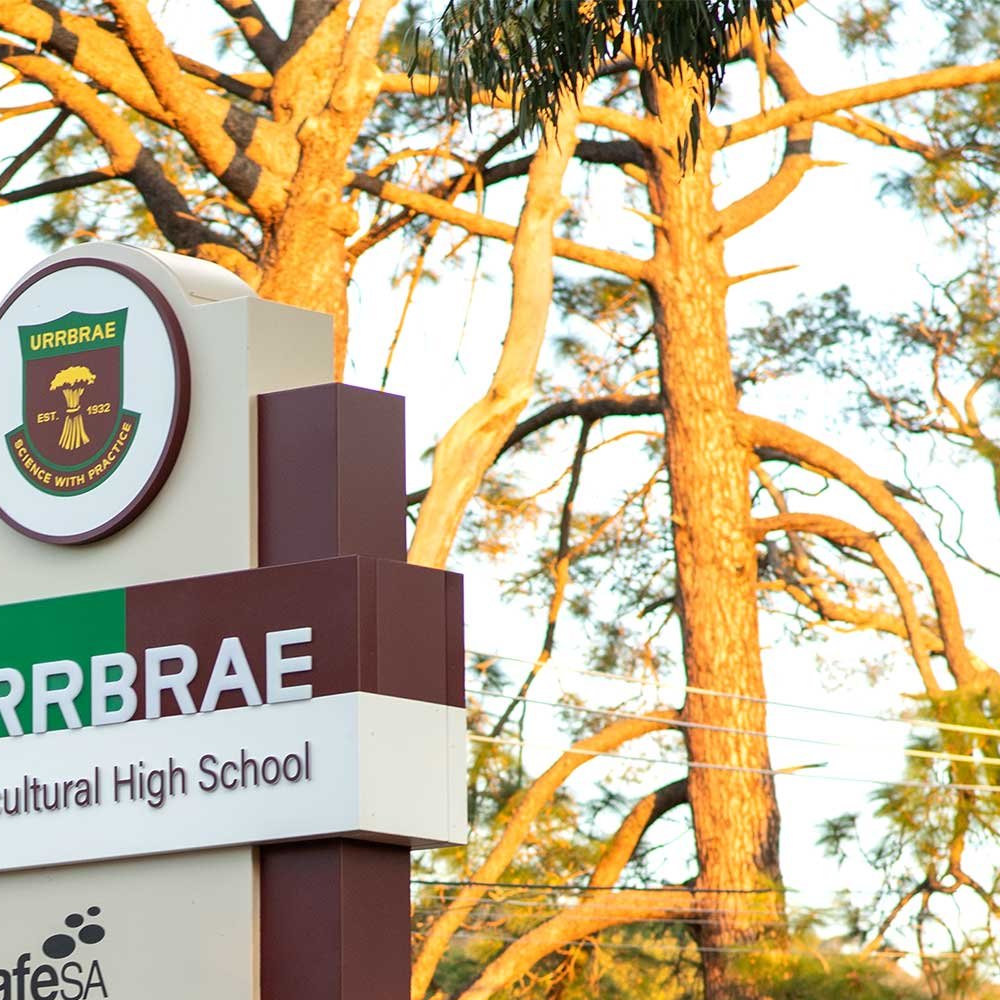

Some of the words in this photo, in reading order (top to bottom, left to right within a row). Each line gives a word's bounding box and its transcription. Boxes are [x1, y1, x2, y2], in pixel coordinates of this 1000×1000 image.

[30, 321, 116, 351] URRBRAE
[37, 411, 60, 424] EST.
[86, 403, 111, 415] 1932
[13, 438, 51, 484] SCIENCE
[54, 474, 85, 488] WITH
[88, 421, 131, 481] PRACTICE
[113, 757, 187, 809] High
[199, 741, 312, 794] School
